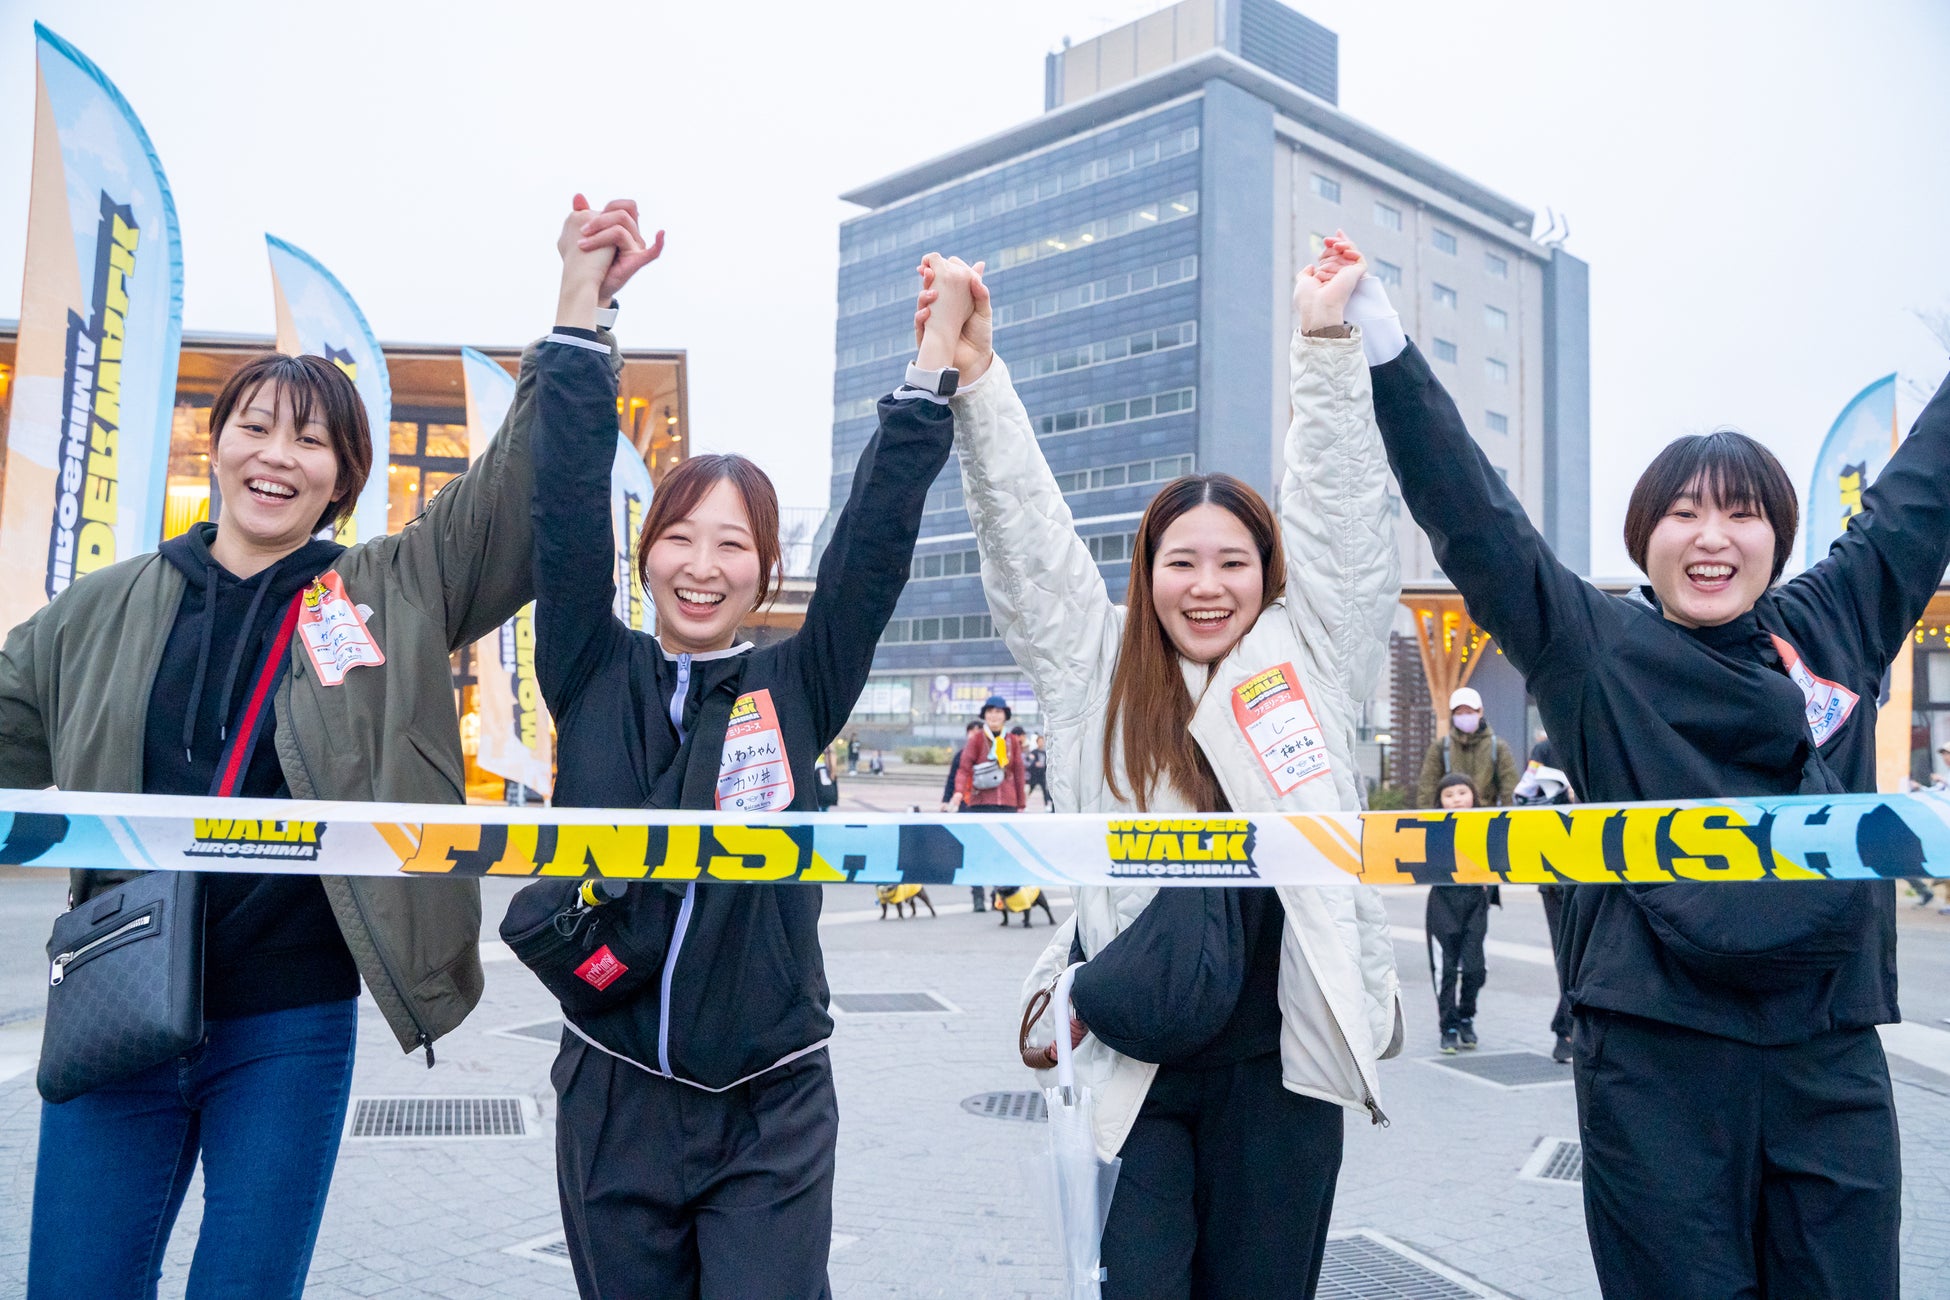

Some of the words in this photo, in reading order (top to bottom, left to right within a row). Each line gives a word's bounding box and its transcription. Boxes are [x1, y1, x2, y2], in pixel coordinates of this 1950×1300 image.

[1239, 673, 1287, 703] WALK
[726, 722, 761, 737] ミリーコース
[193, 817, 318, 843] WALK
[1106, 819, 1250, 833] WONDER
[188, 841, 316, 857] HIROSHIMA
[399, 822, 905, 882] FINISH
[1105, 833, 1249, 861] WALK
[1357, 803, 1885, 884] FINISH
[1107, 862, 1253, 877] HIROSHIMA
